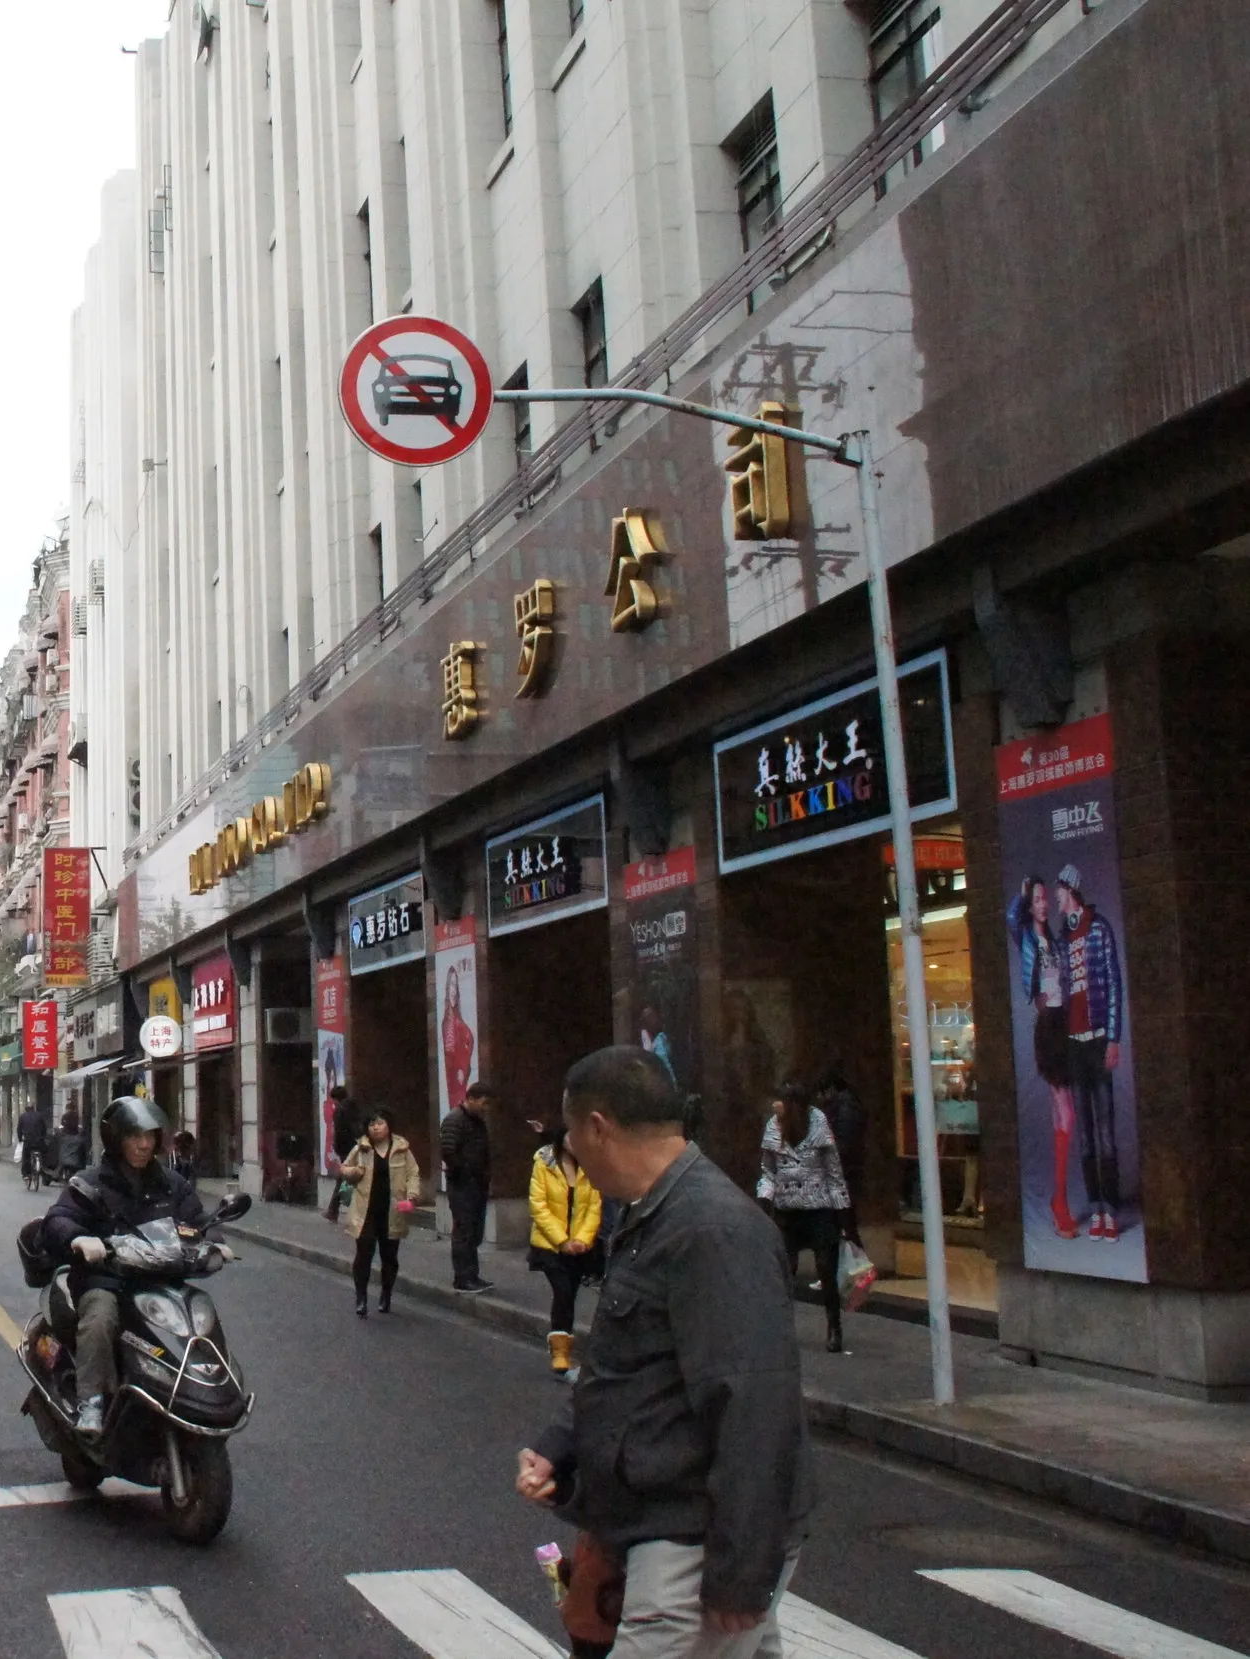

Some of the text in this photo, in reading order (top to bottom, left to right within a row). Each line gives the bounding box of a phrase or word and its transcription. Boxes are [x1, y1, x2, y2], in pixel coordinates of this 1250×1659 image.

[440, 401, 794, 742] 惠罗公司
[1051, 801, 1103, 832] 雪中飞
[365, 902, 410, 945] 惠罗钻石
[149, 1038, 173, 1050] 特产
[150, 1025, 172, 1036] 上海
